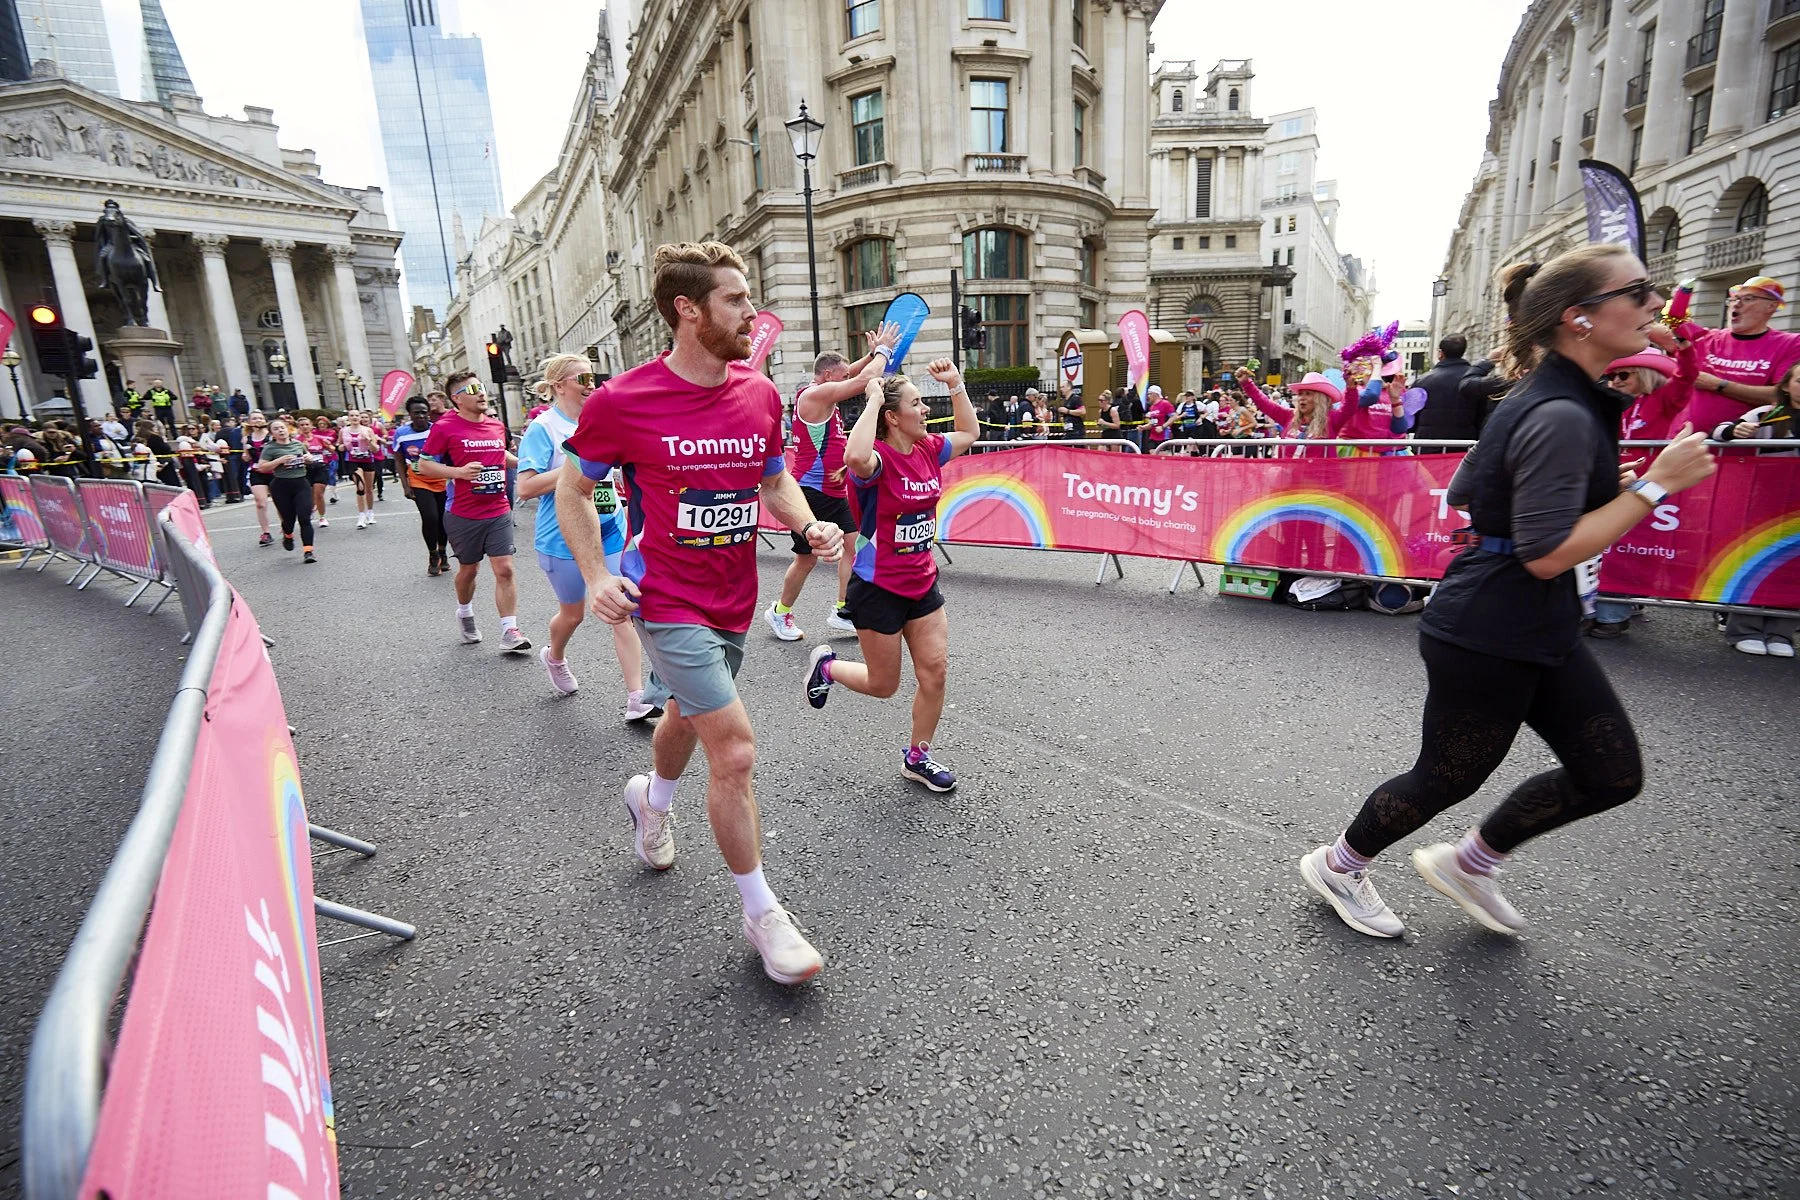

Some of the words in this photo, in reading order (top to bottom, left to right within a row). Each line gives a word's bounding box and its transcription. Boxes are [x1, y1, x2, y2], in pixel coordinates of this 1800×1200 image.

[461, 438, 504, 448] Tommy's
[661, 434, 766, 458] Tommy's
[682, 463, 717, 471] pregnancy
[719, 461, 730, 469] and
[714, 492, 737, 500] JIMMY
[1063, 472, 1199, 516] Tommy's
[686, 504, 752, 528] 10291
[1061, 507, 1075, 515] The
[1076, 508, 1120, 522] pregnancy
[1138, 517, 1161, 528] baby
[1163, 520, 1196, 533] charity
[900, 521, 934, 540] 10292
[1425, 532, 1450, 543] The
[1616, 543, 1676, 559] charity
